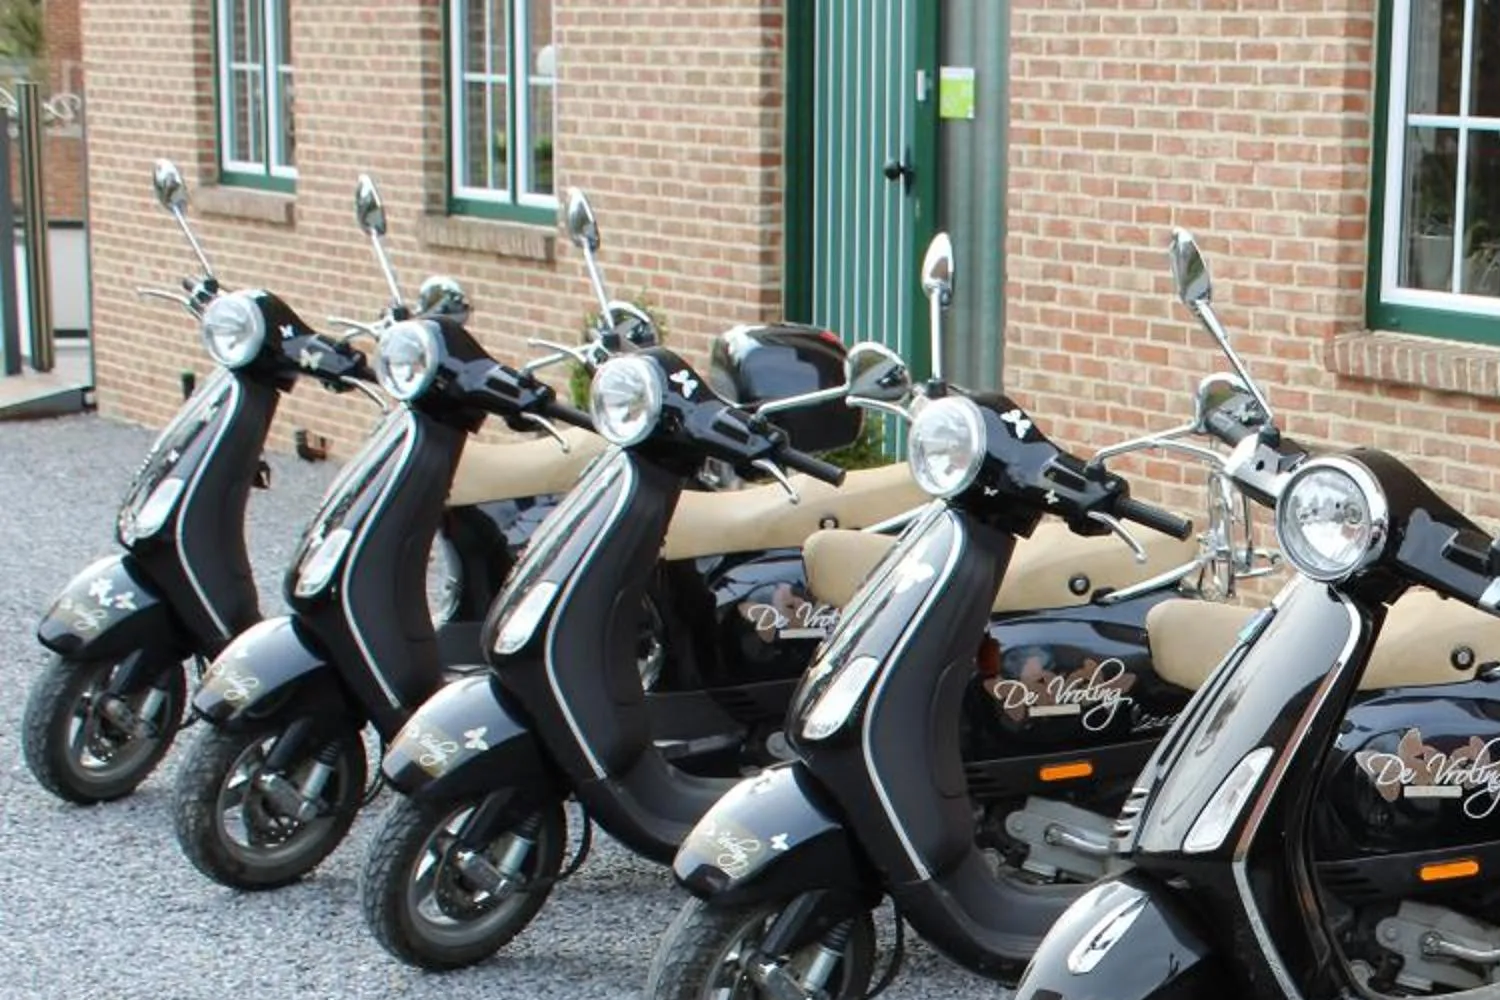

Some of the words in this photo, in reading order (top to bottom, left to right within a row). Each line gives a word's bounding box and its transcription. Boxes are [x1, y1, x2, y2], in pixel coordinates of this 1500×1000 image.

[747, 603, 789, 631] De
[993, 679, 1039, 709] De
[1366, 753, 1417, 785] De
